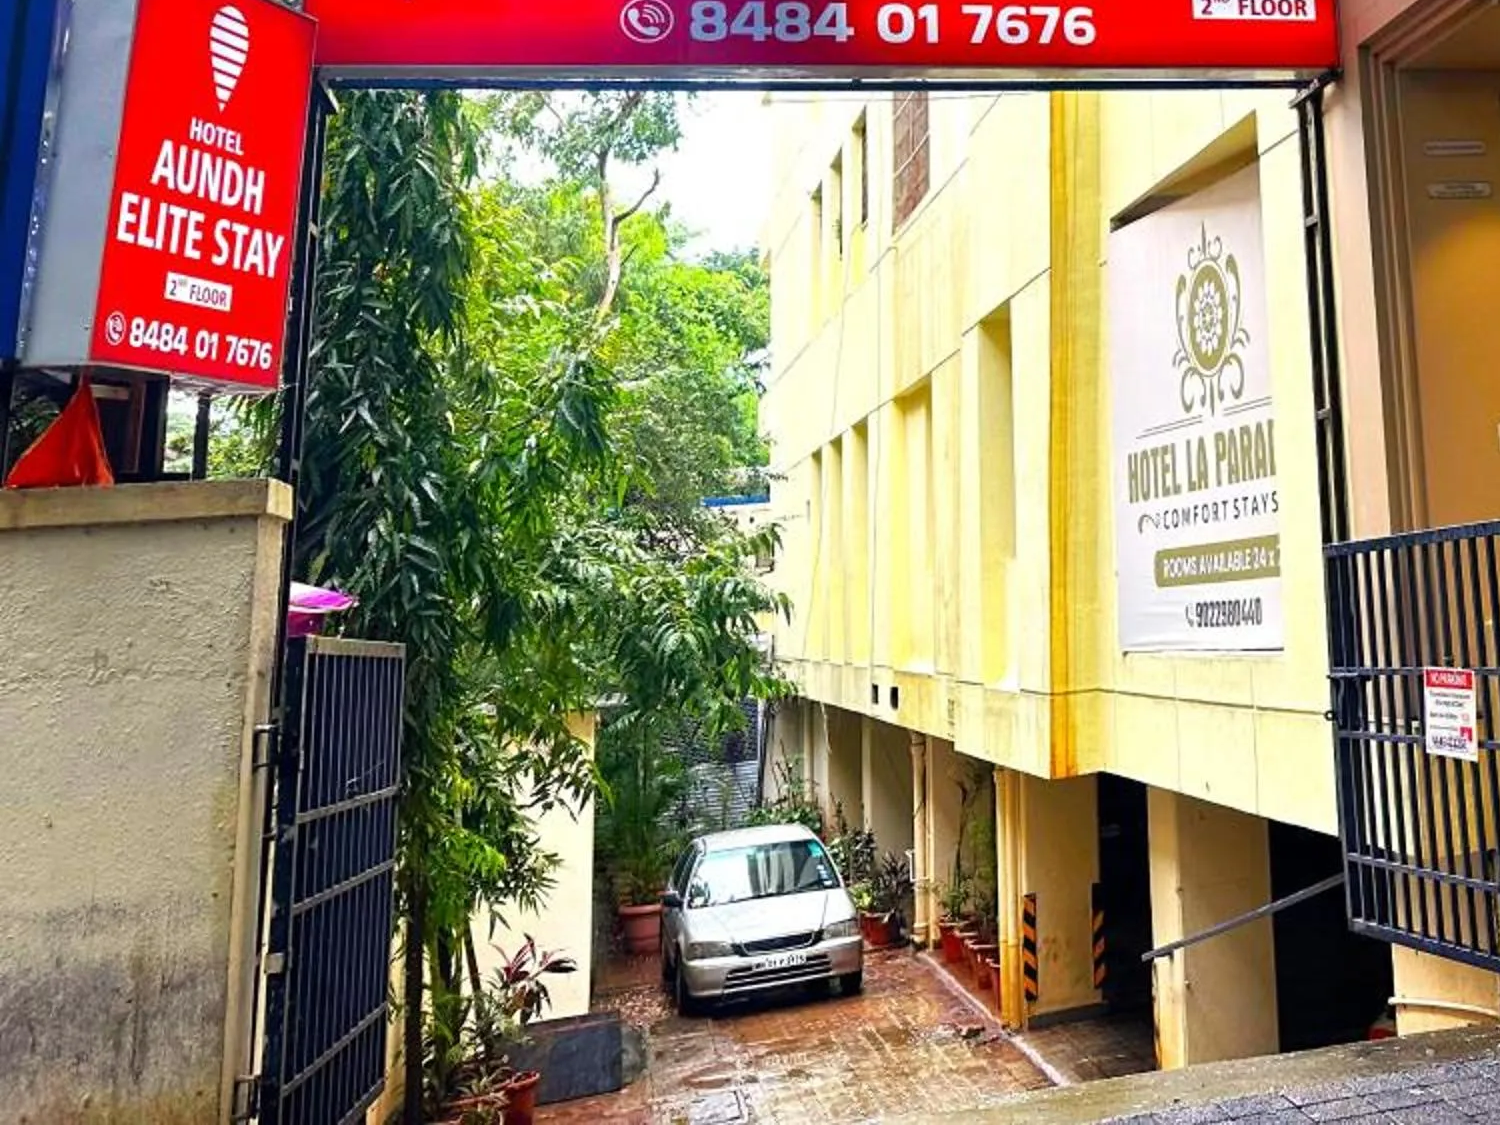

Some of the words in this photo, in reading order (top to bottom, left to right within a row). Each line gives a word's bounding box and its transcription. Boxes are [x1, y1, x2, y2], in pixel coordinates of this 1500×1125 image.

[876, 0, 940, 45] 01
[961, 2, 1098, 48] 7676
[189, 117, 244, 157] HOTEL
[150, 139, 266, 217] AUNDH
[116, 192, 203, 260] ELITE
[212, 217, 285, 278] STAY
[189, 284, 227, 308] FLOOR
[128, 316, 189, 356] 8484
[194, 328, 220, 361] 01
[225, 334, 273, 371] 7676
[1127, 442, 1182, 504] HOTEL
[1185, 435, 1209, 493] LA
[1162, 499, 1229, 530] COMFORT
[1233, 490, 1279, 520] STAYS
[1200, 547, 1252, 576] AVAILABLE
